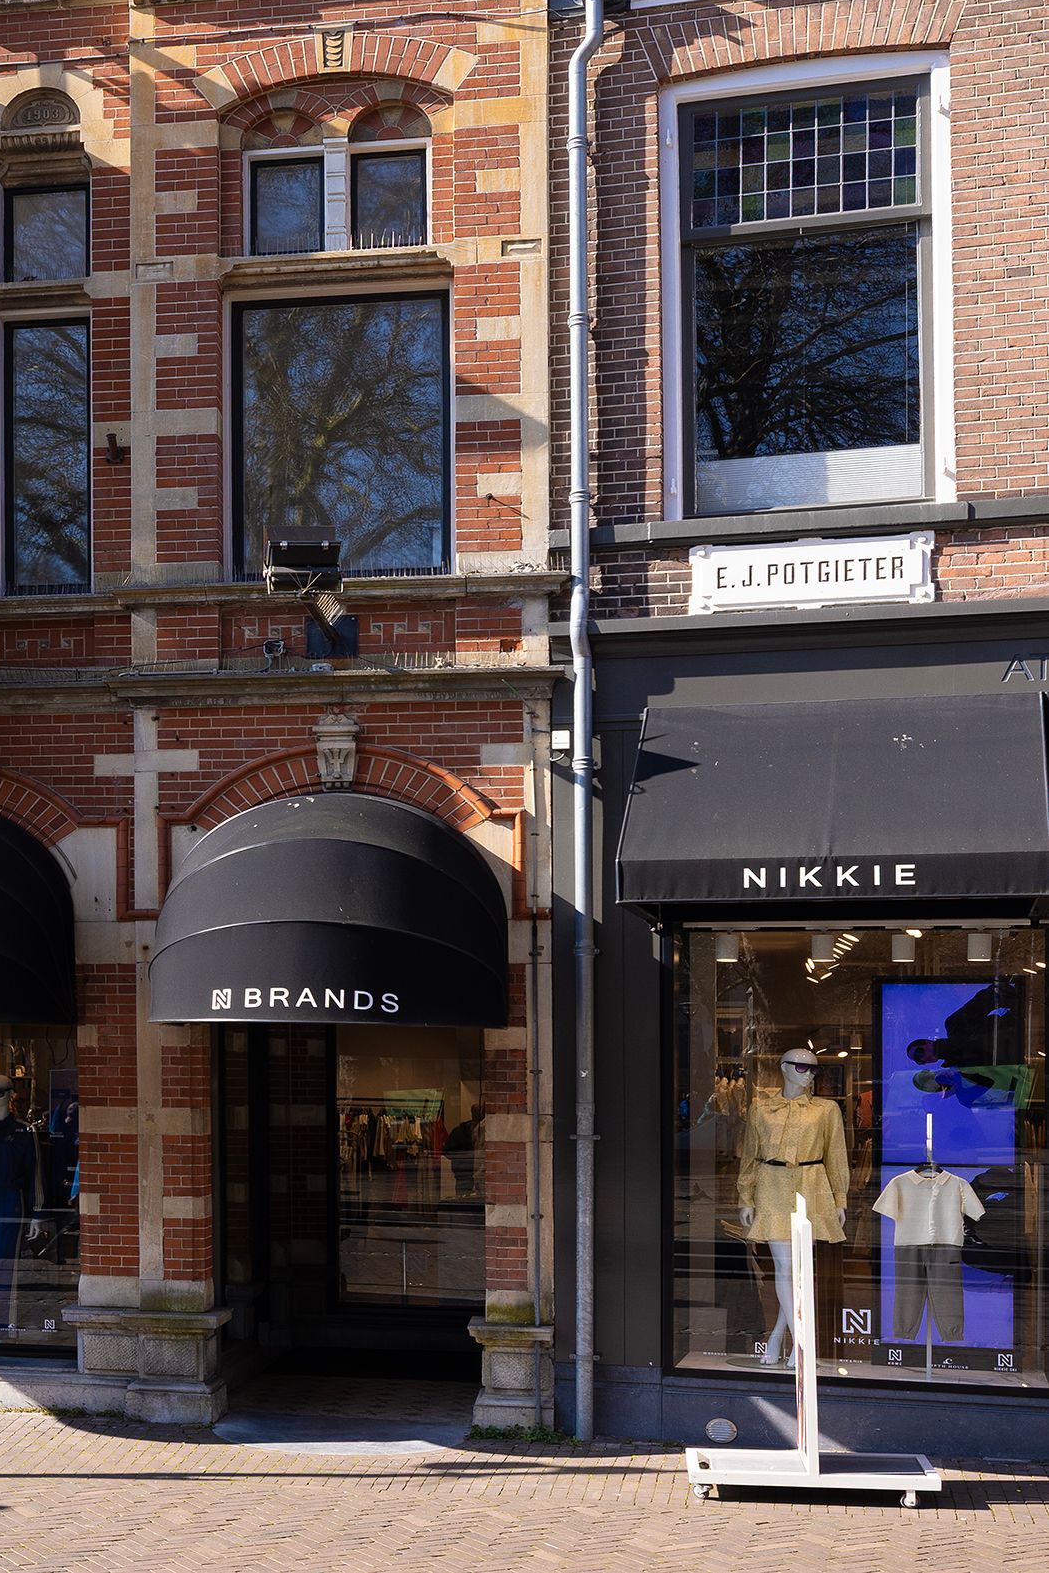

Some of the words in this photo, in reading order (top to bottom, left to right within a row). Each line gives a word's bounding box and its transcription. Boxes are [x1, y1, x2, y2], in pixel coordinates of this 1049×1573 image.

[26, 109, 59, 121] 1903
[743, 864, 916, 889] NIKKIE
[244, 987, 400, 1014] BRANDS
[833, 1336, 881, 1346] NIKKIE
